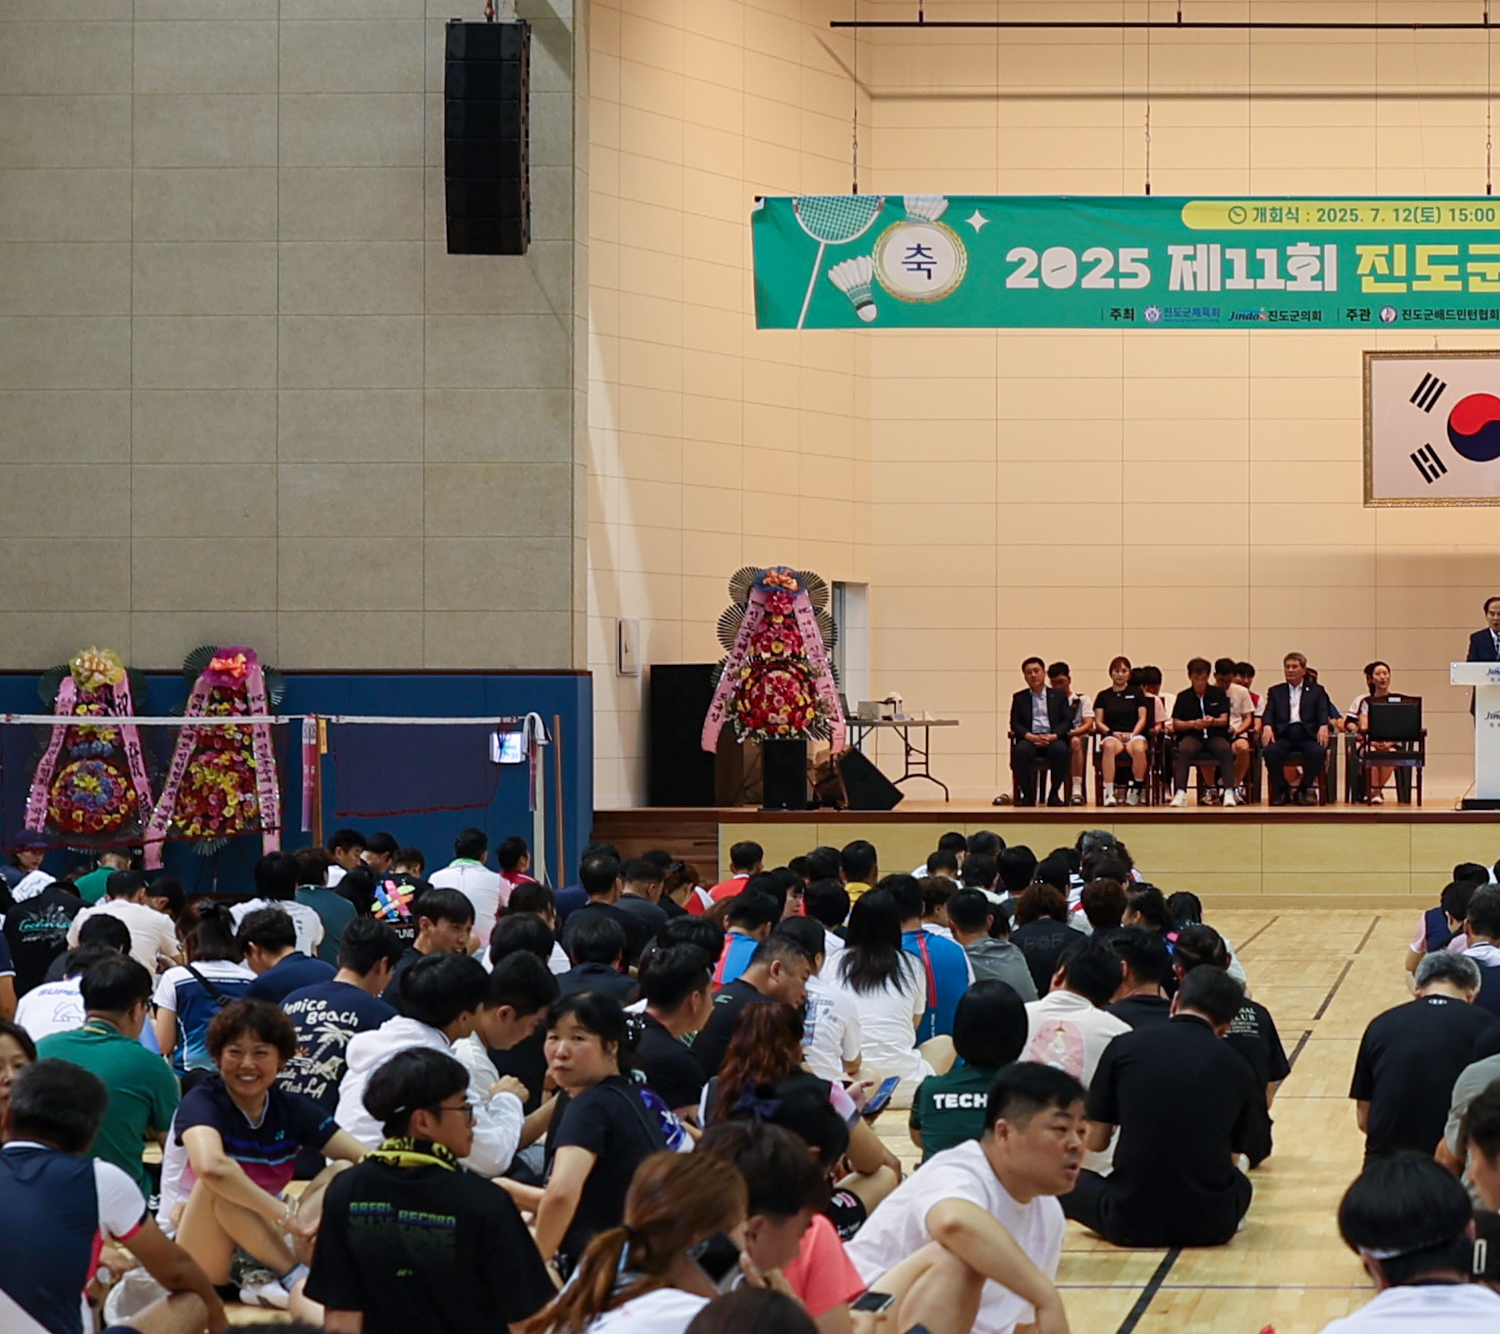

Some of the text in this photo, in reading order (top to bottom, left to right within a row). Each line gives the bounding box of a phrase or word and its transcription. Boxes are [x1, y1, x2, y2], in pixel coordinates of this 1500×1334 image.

[1252, 207, 1300, 224] 개회식
[1316, 208, 1364, 223] 2025.
[1392, 207, 1441, 225] 12(토)
[1449, 208, 1496, 223] 15:00
[901, 242, 938, 281] 축
[1004, 246, 1151, 290] 2025
[1167, 242, 1338, 292] 제11회
[1109, 307, 1135, 322] 주최
[1345, 308, 1371, 322] 주관
[1401, 308, 1500, 322] 진도군배드민턴협회
[305, 1009, 359, 1027] Beach
[932, 1092, 989, 1110] TECH
